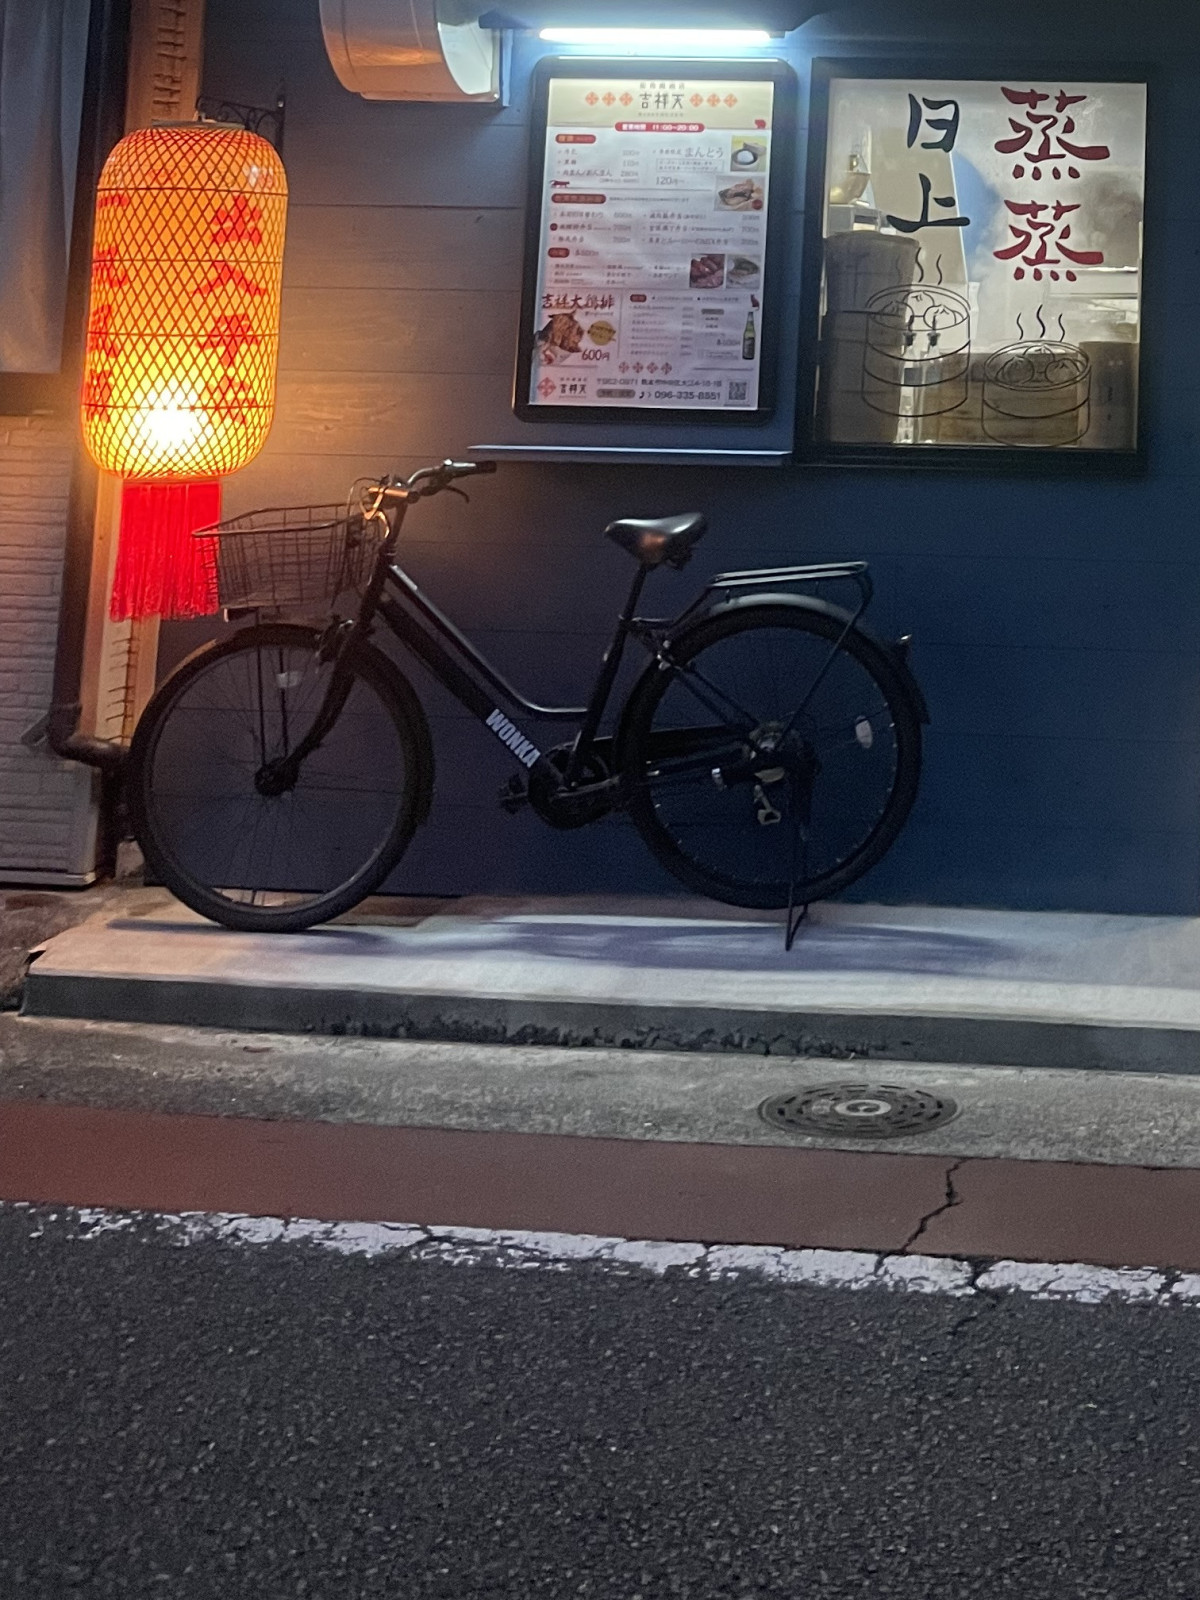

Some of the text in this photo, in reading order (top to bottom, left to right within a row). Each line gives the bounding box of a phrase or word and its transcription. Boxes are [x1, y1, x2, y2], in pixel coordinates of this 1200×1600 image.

[639, 91, 685, 109] 吉祥天
[485, 708, 541, 769] WONKA
